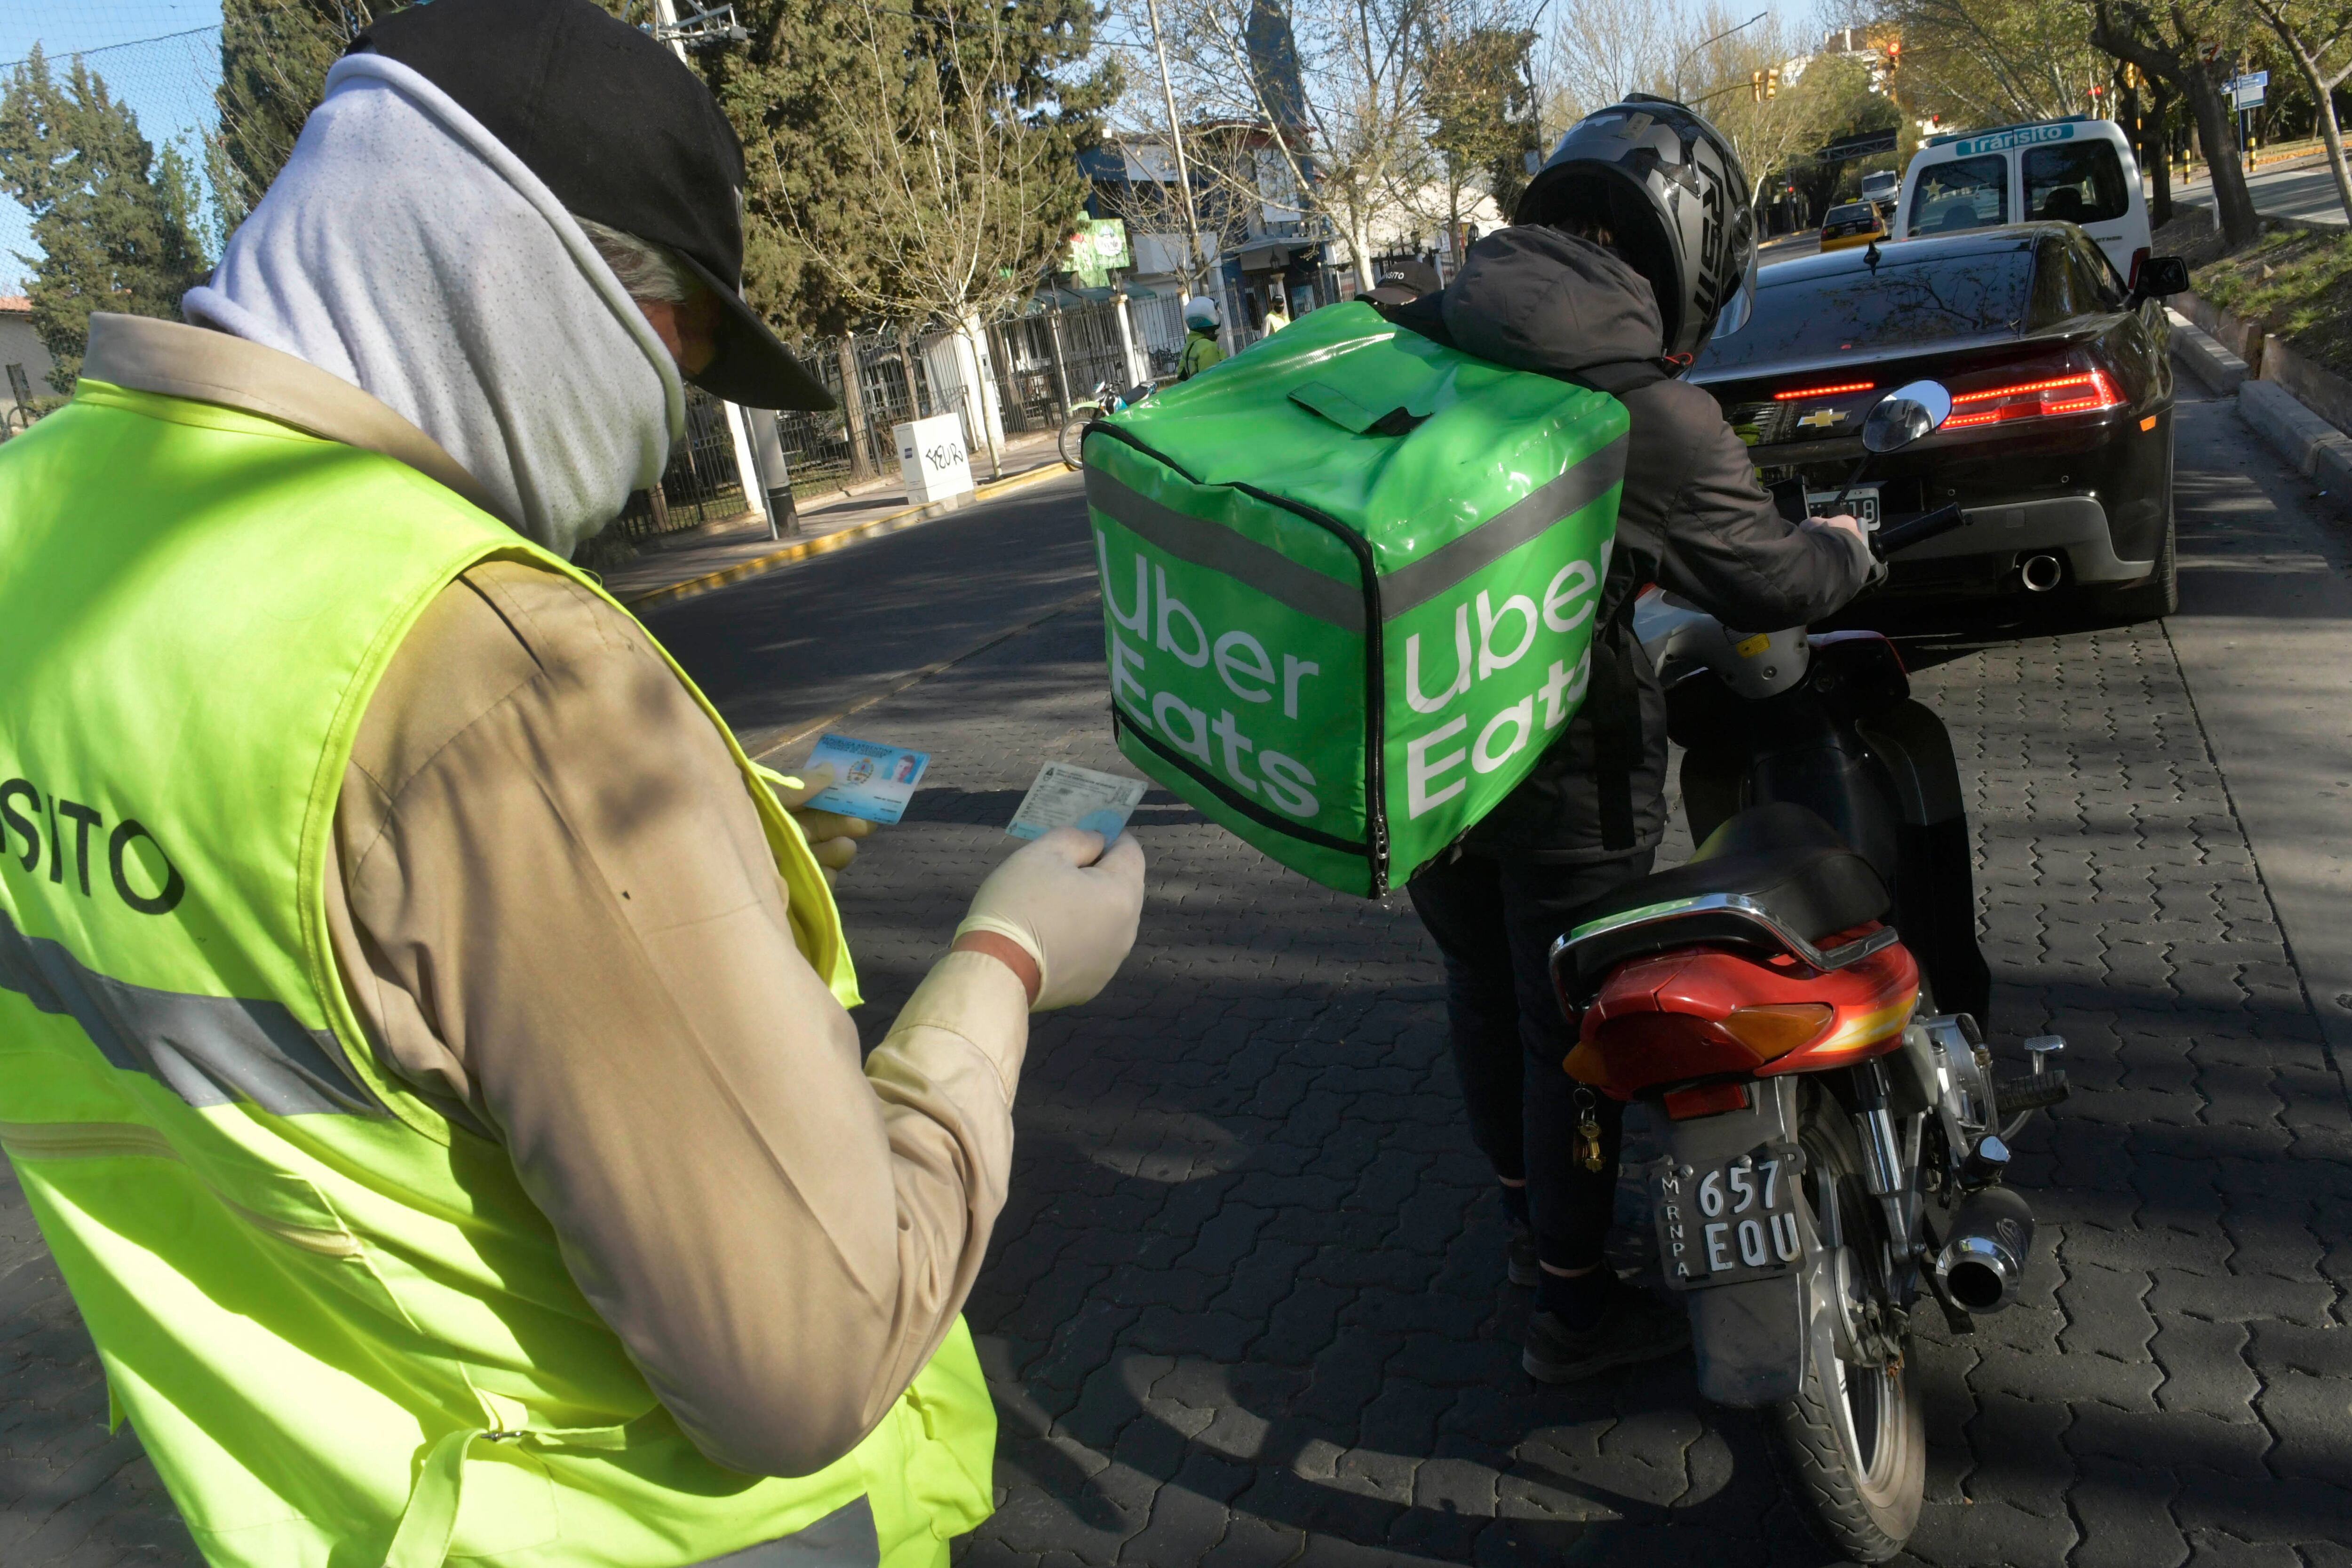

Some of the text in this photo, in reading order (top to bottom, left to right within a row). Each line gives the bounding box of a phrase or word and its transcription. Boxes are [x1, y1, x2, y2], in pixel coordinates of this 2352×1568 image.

[1967, 127, 2062, 153] Tránsito
[1097, 529, 1319, 720] Uber
[1112, 626, 1319, 818] Eats
[0, 778, 185, 915] SITO
[1700, 1160, 1779, 1217] 657
[1704, 1212, 1801, 1271] EQU
